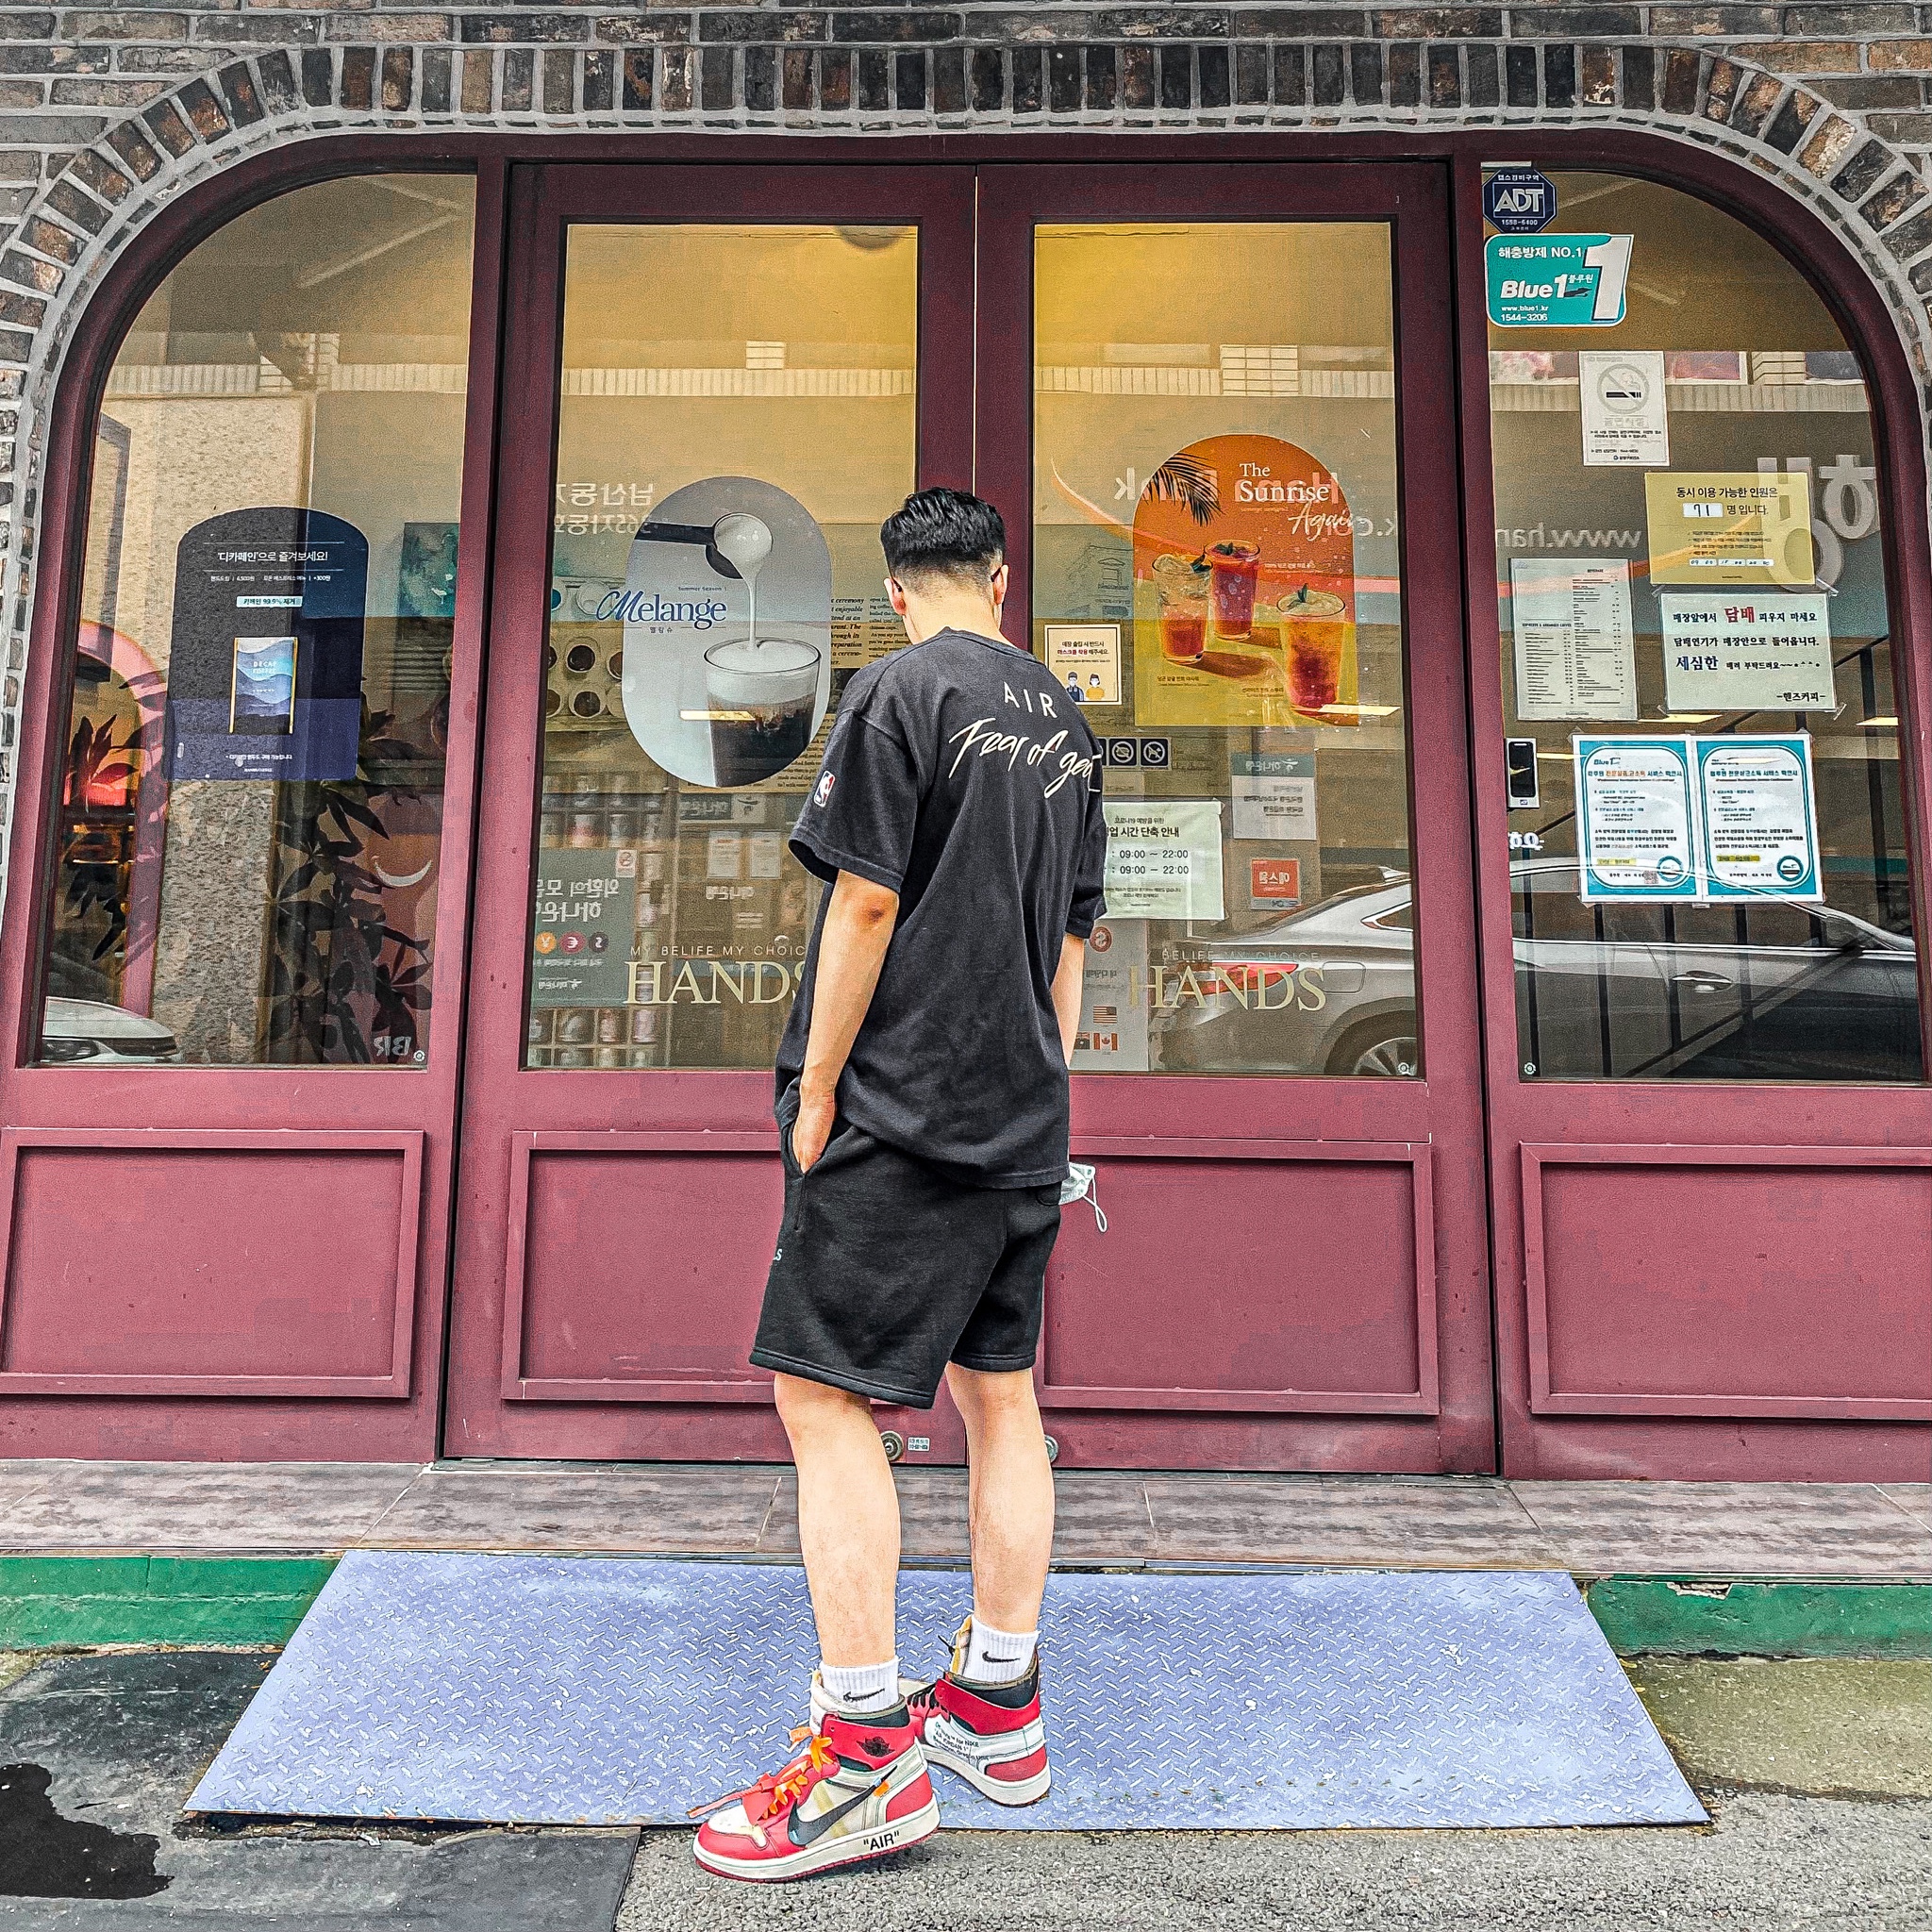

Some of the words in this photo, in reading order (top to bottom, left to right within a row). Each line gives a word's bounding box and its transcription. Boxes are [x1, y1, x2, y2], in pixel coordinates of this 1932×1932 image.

[1493, 189, 1544, 212] ADT
[1498, 246, 1546, 259] 해충방제
[1551, 246, 1582, 258] NO.1
[1568, 274, 1594, 284] 블루원
[1500, 274, 1568, 299] Blue1
[1500, 313, 1548, 322] 1544-3206
[1239, 462, 1271, 477] The
[1239, 479, 1329, 502] Sunrise
[1676, 487, 1695, 498] 동시
[1698, 487, 1716, 498] 이용
[1719, 487, 1748, 498] 가능한
[1749, 487, 1778, 498] 인원은
[1727, 504, 1737, 515] 명
[1740, 504, 1769, 515] 입니다.
[278, 551, 328, 562] 즐겨보세요!
[596, 590, 727, 630] Melange
[835, 606, 864, 617] enjoyable
[1674, 613, 1717, 623] 매장앞에서
[1724, 607, 1756, 623] 담배
[1759, 613, 1785, 623] 피우지
[1790, 612, 1818, 622] 마세요
[1674, 637, 1719, 647] 담배연기가
[1723, 637, 1767, 647] 매장안으로
[1676, 656, 1719, 671] 세심한
[1004, 681, 1058, 719] AIR
[948, 717, 1030, 779] Fear
[1027, 730, 1069, 767] of
[1121, 826, 1139, 838] 시간
[1141, 826, 1159, 838] 단축
[1160, 826, 1180, 838] 안내
[1119, 849, 1146, 858] 09:00
[1162, 849, 1189, 858] 22:00
[1120, 865, 1146, 874] 09:00
[1163, 865, 1189, 874] 22:00
[661, 946, 714, 956] BELIFE
[723, 946, 744, 956] MY
[754, 946, 806, 956] CHOIC
[1256, 952, 1320, 961] CHOICE
[1127, 965, 1326, 1011] HANDS
[964, 1740, 981, 1748] NIKE
[863, 1830, 900, 1851] "AIR"
